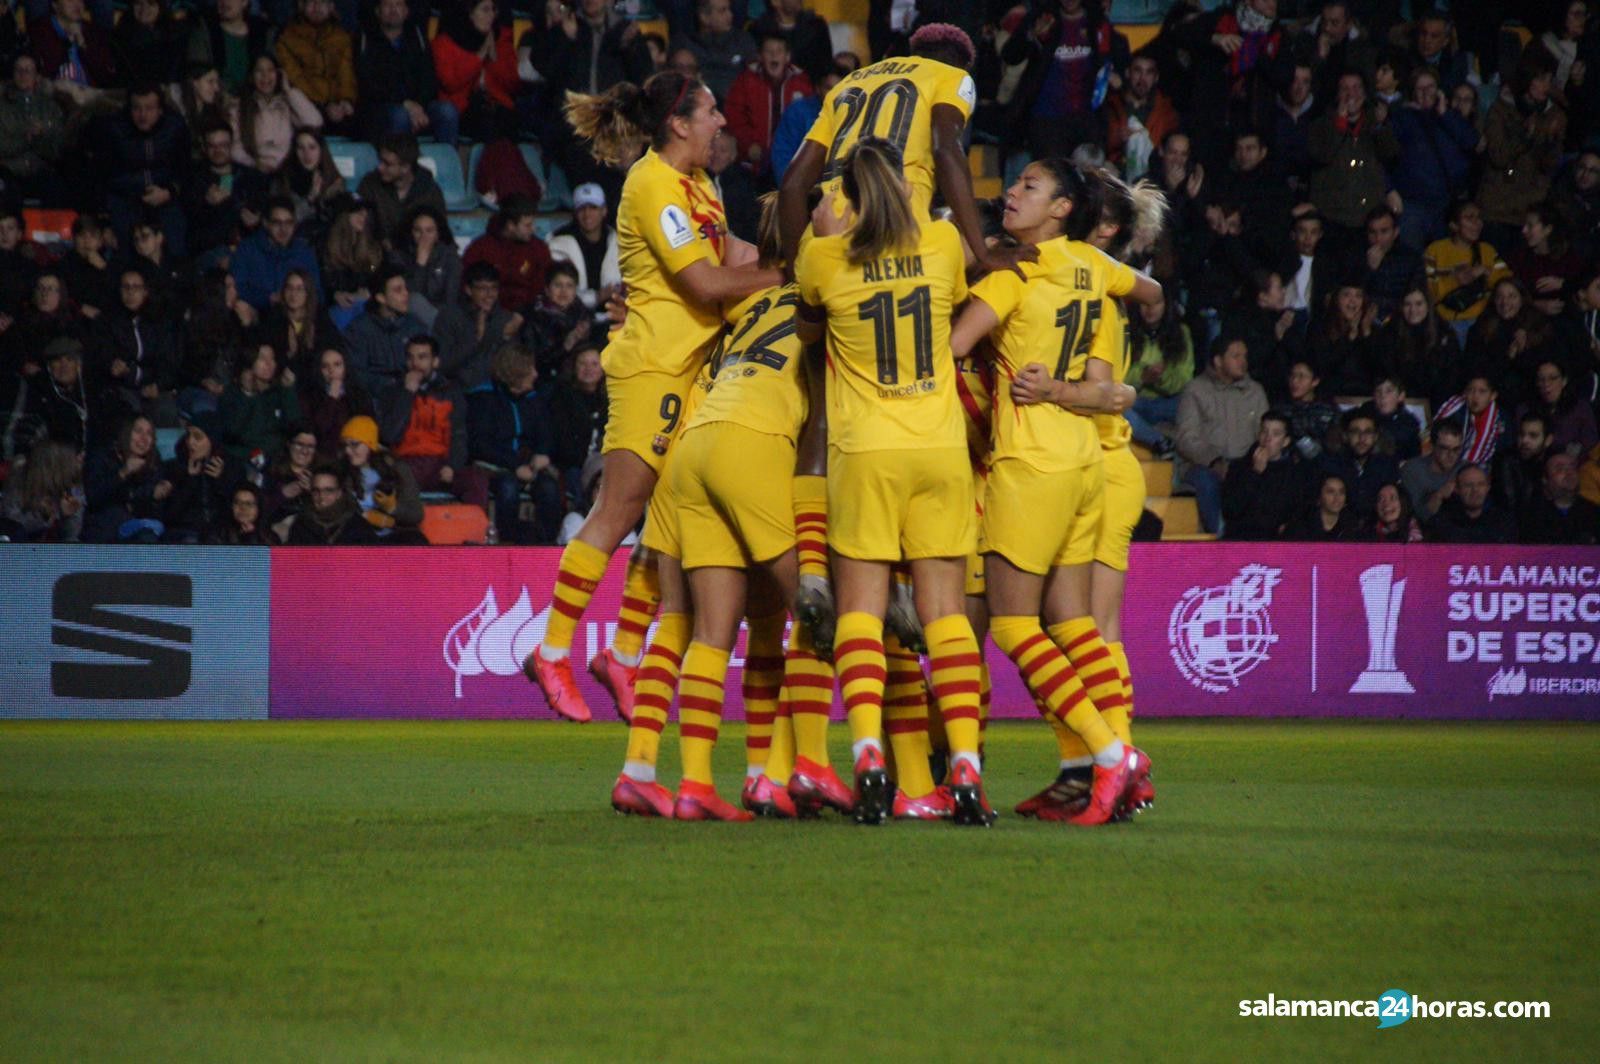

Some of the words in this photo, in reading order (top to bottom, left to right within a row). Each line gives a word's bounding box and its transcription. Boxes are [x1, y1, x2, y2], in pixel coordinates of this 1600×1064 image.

[816, 78, 919, 183] 20
[862, 255, 925, 283] ALEXIA
[857, 283, 935, 385] 11
[877, 381, 919, 399] unicef
[660, 393, 682, 434] 9
[1447, 564, 1600, 587] SALAMANC
[1447, 630, 1504, 663] DE
